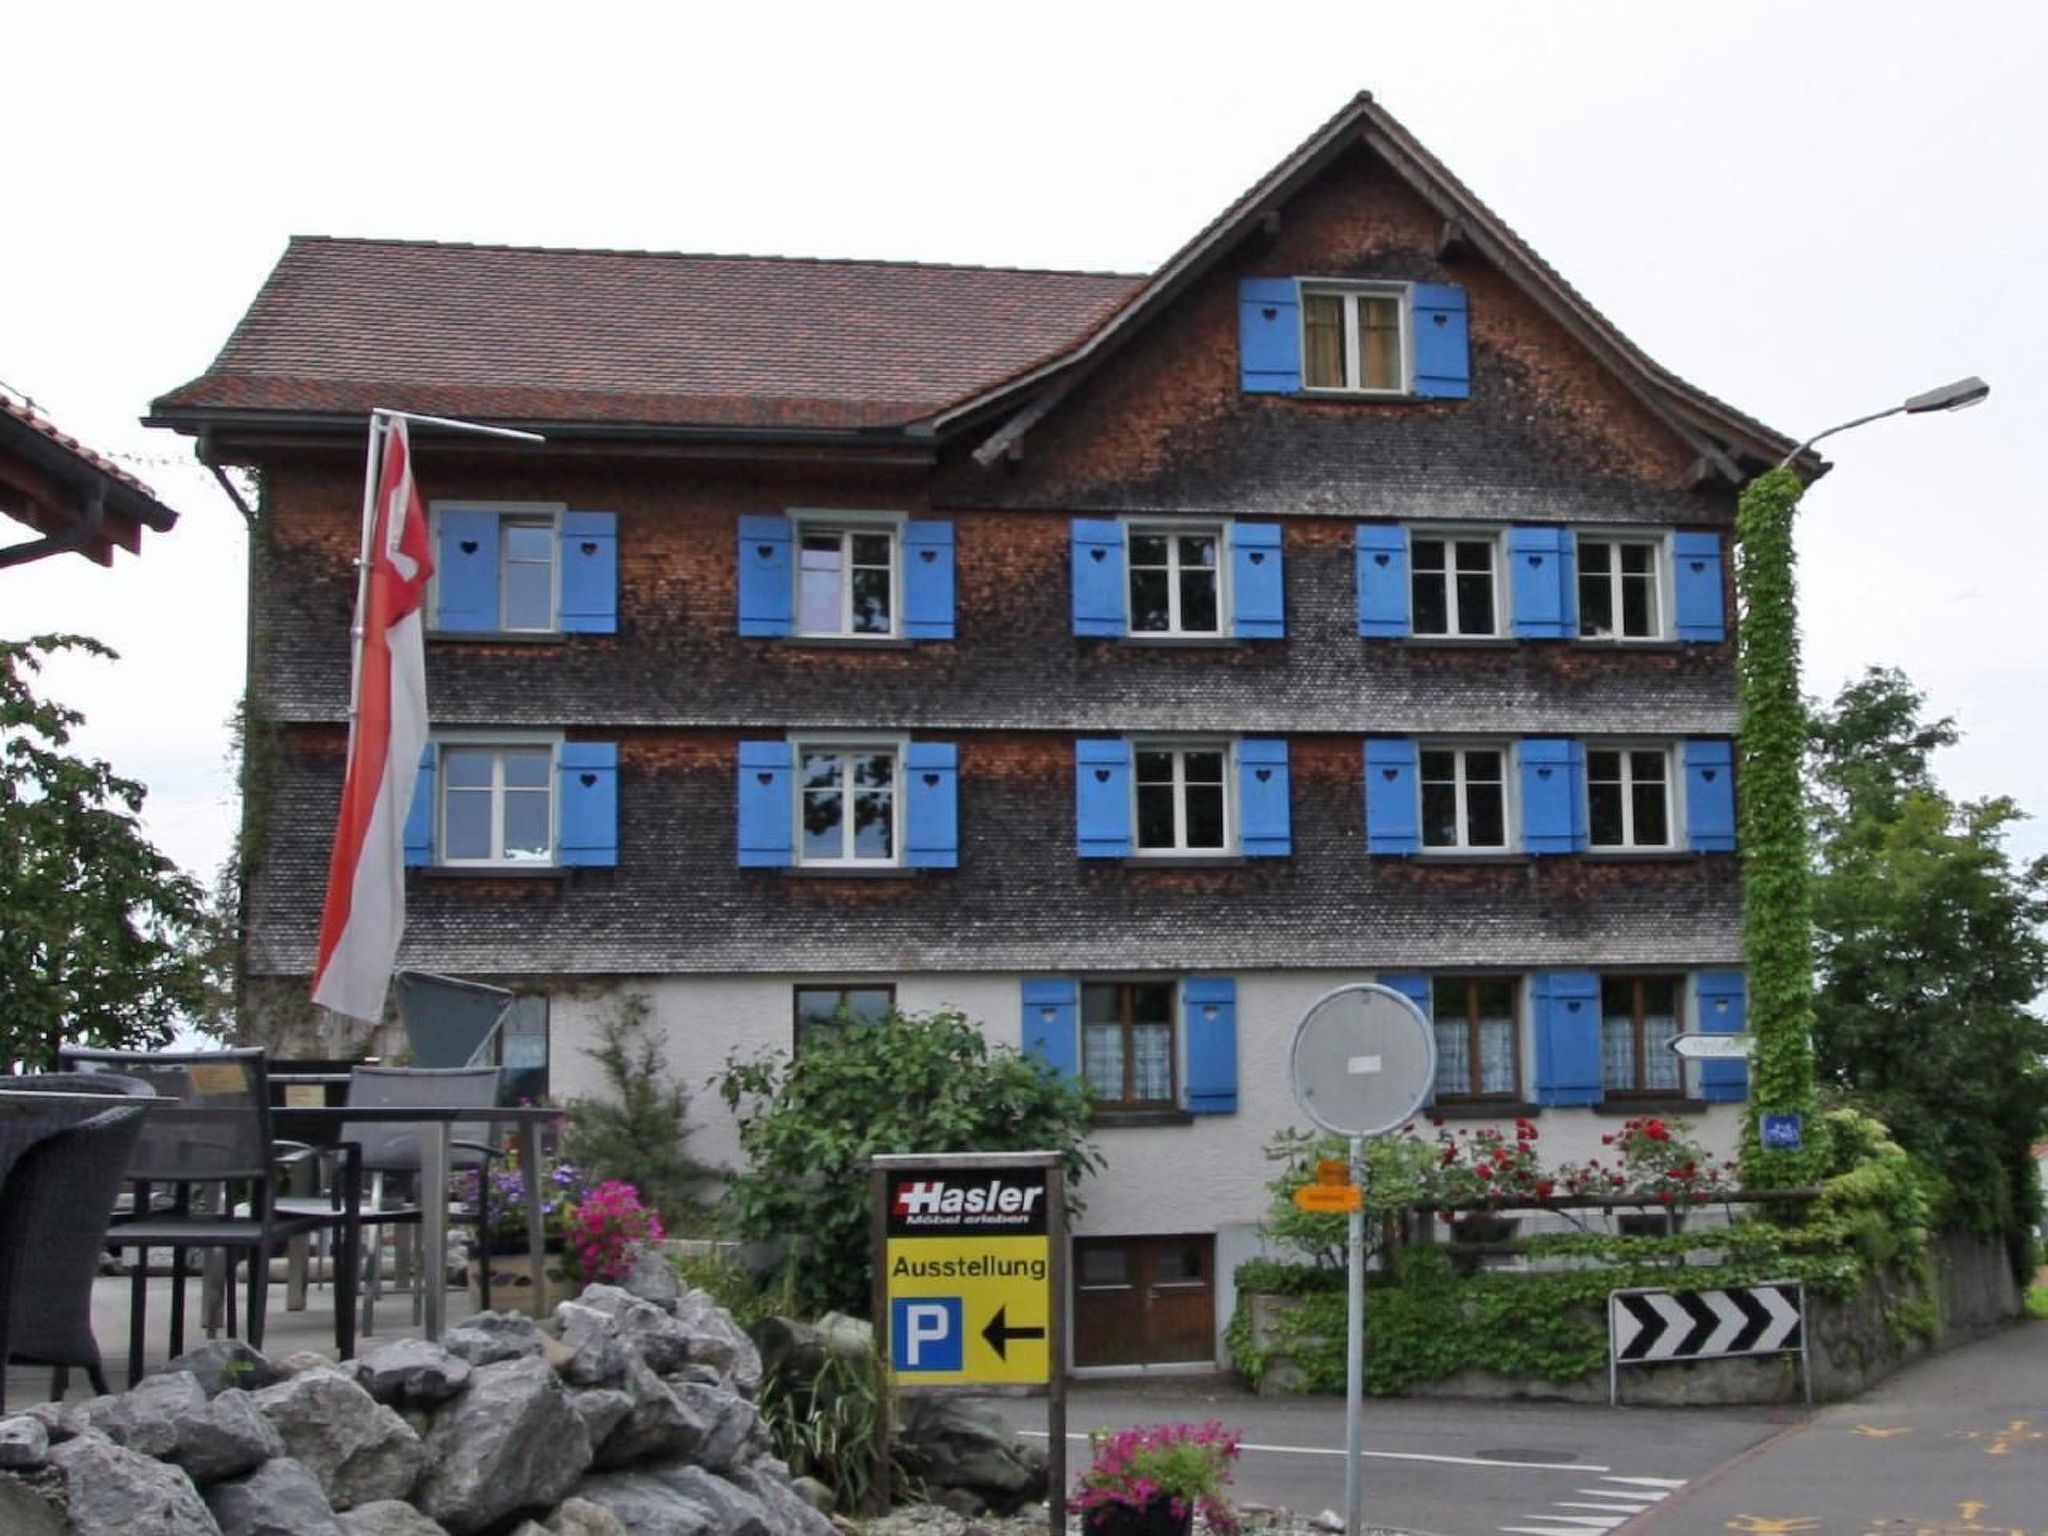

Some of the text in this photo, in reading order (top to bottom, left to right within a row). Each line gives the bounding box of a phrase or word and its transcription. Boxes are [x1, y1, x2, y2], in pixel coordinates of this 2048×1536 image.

[898, 1180, 1044, 1214] Hasler
[892, 1255, 1046, 1281] Ausstellung
[907, 1304, 949, 1366] P
